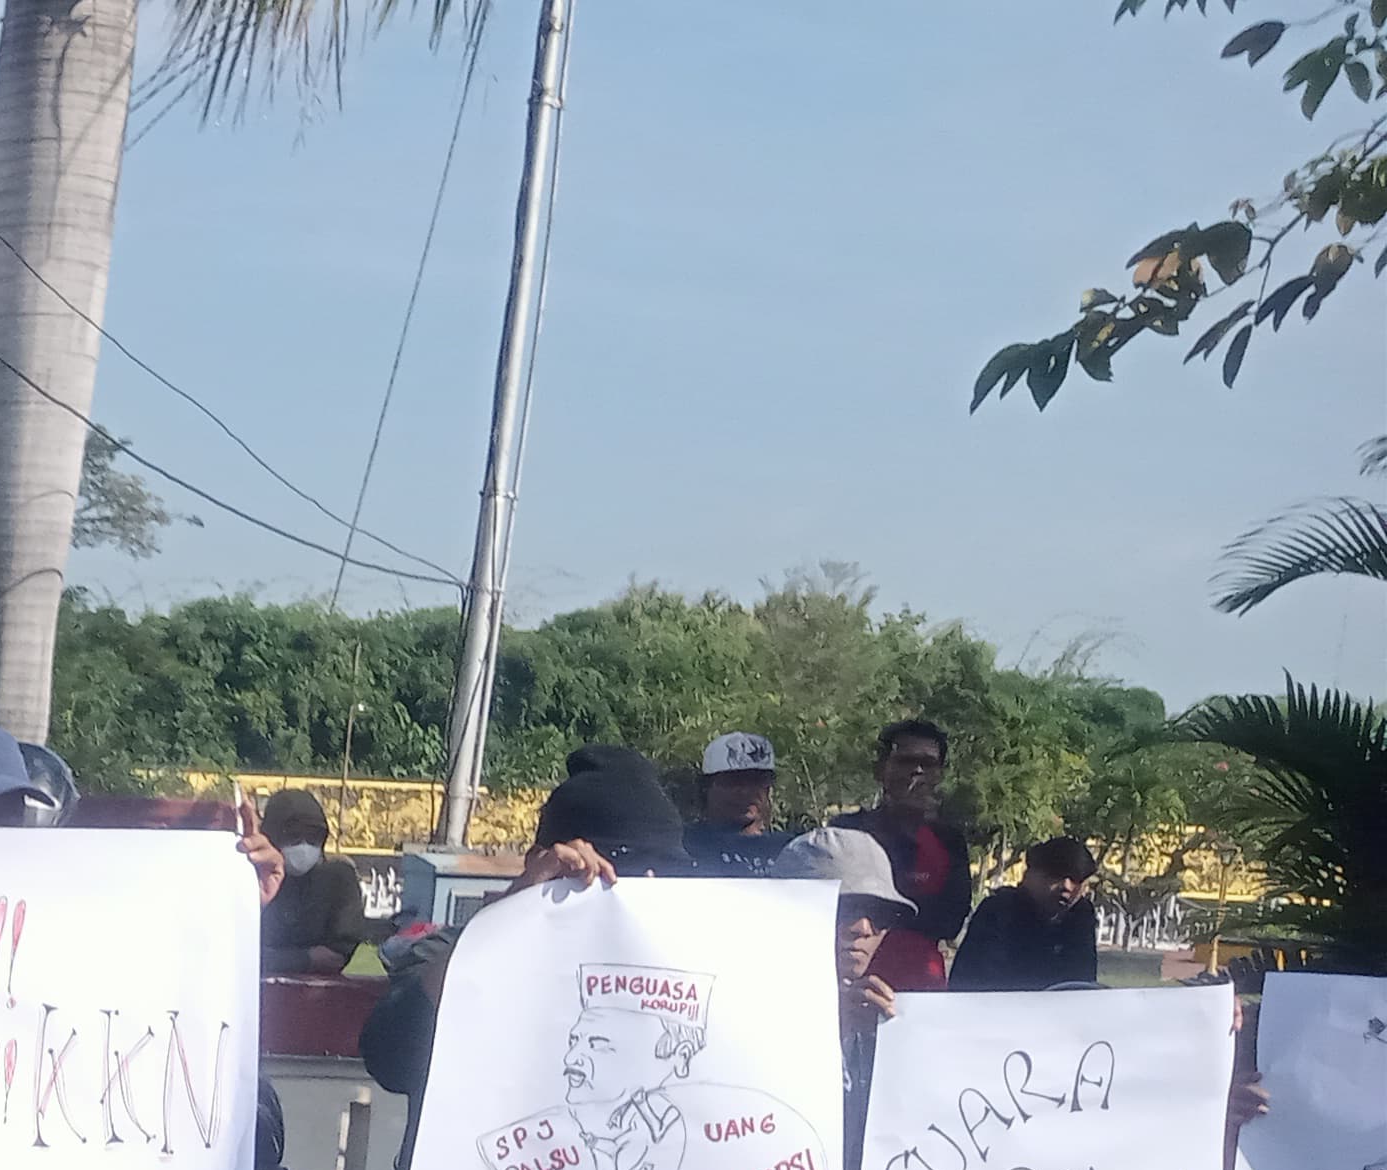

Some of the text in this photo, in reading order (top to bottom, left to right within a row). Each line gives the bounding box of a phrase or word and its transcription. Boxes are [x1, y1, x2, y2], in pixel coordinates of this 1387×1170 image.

[586, 975, 698, 1001] PENGUASA
[33, 1003, 229, 1160] KKN
[703, 1113, 777, 1143] UANG
